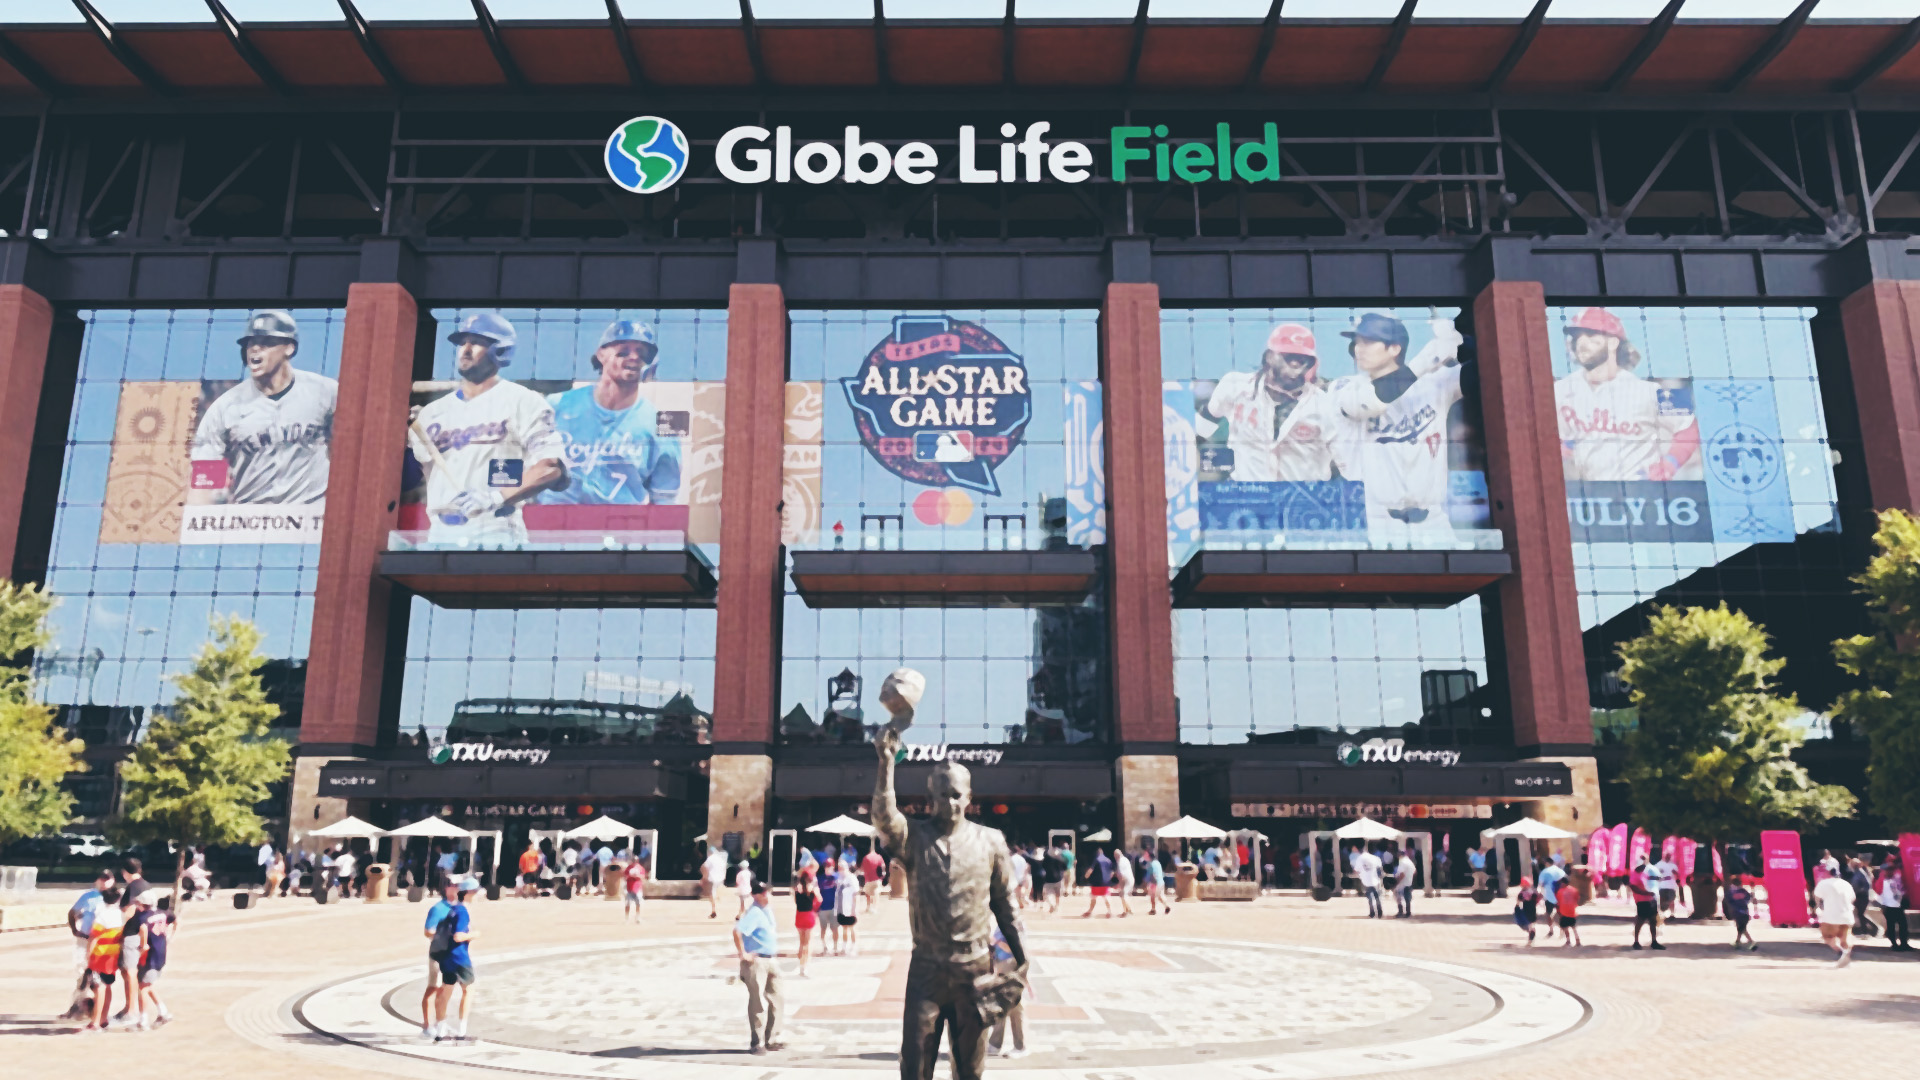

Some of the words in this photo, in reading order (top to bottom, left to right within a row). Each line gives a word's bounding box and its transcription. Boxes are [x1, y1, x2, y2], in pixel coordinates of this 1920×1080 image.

[714, 125, 939, 185] Globe
[959, 121, 1093, 184] Life
[1111, 122, 1281, 183] Field
[935, 364, 1027, 396] STAR
[890, 396, 997, 427] GAME
[1560, 405, 1642, 436] Phillies
[610, 471, 628, 500] 7
[1654, 497, 1699, 526] 16
[452, 742, 494, 761] TXU
[493, 749, 550, 765] energy
[906, 743, 948, 761] TXU
[947, 749, 1004, 765] energy
[1361, 744, 1404, 762] TXU
[1403, 750, 1461, 767] energy
